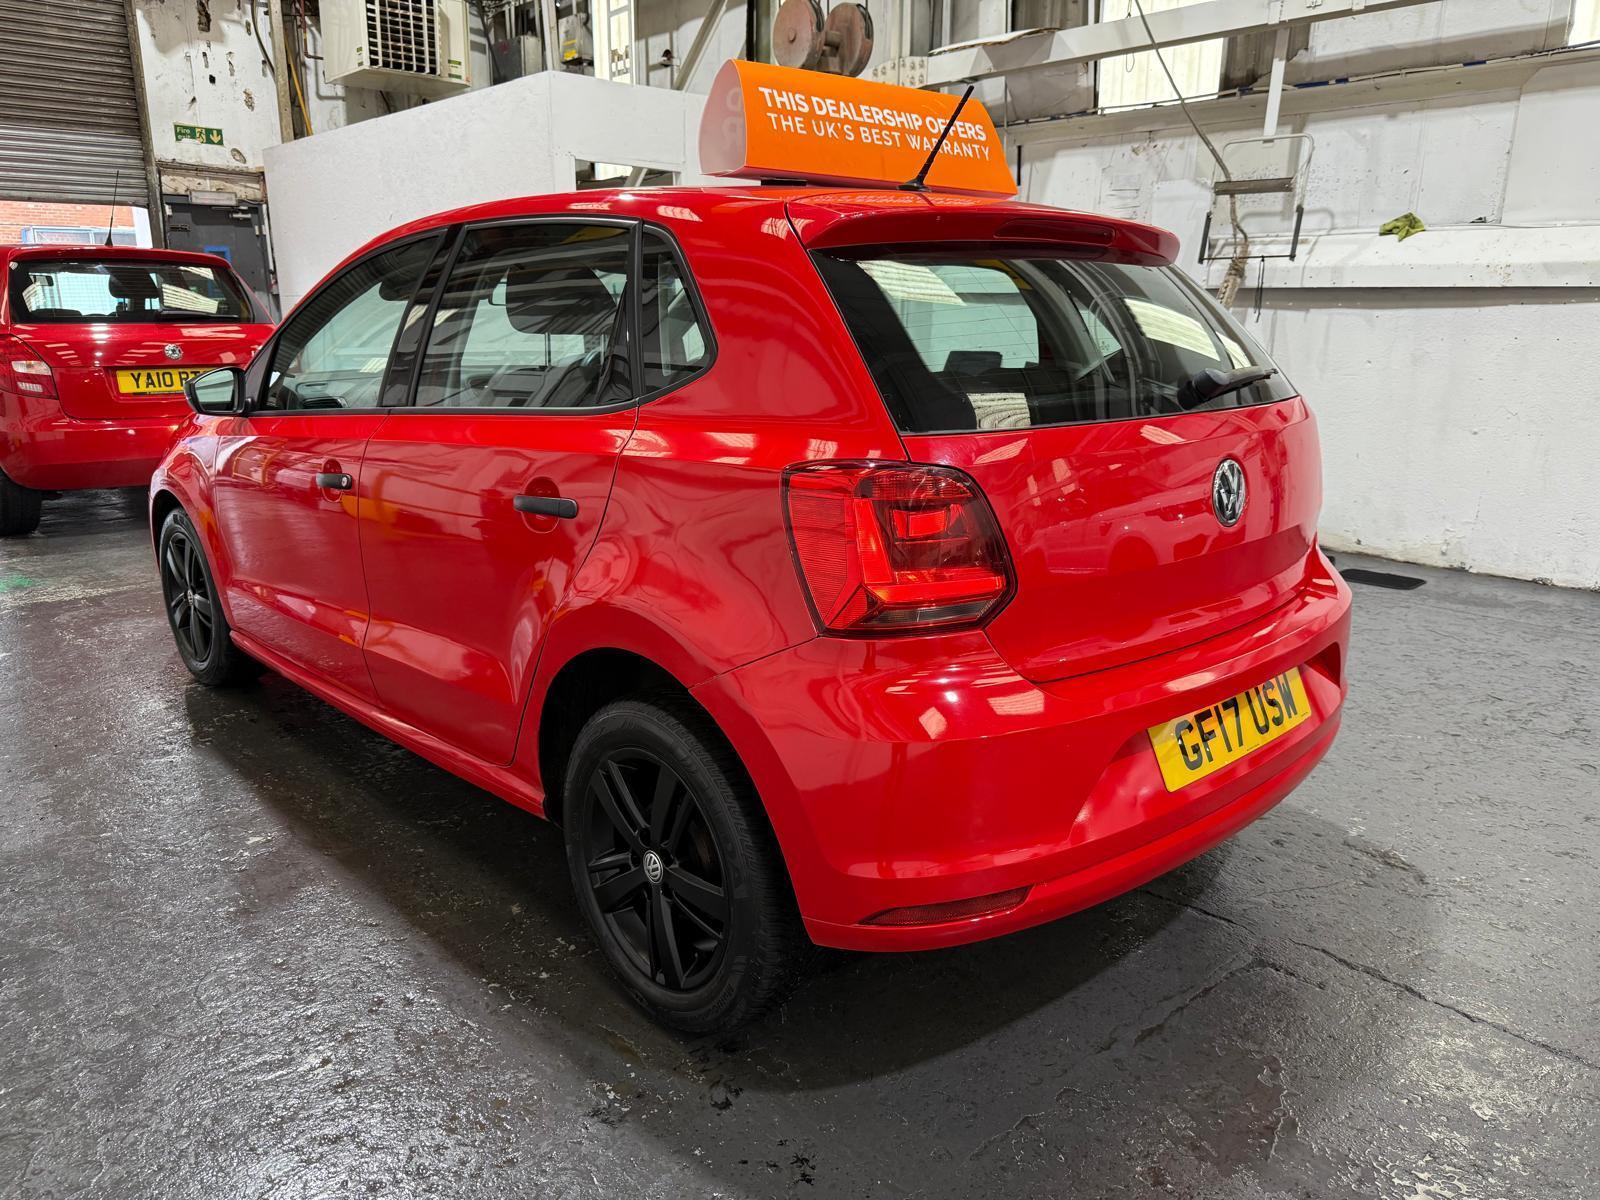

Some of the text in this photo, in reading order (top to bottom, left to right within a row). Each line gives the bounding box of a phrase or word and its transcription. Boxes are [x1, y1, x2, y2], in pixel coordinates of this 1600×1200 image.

[757, 86, 810, 113] THIS
[811, 95, 923, 131] DEALERSHIP
[176, 126, 190, 134] Fire
[765, 112, 808, 135] THE
[811, 119, 855, 141] UK'S
[859, 126, 901, 147] BEST
[130, 370, 206, 389] YA10 RT
[1174, 673, 1298, 771] GF17 USW
